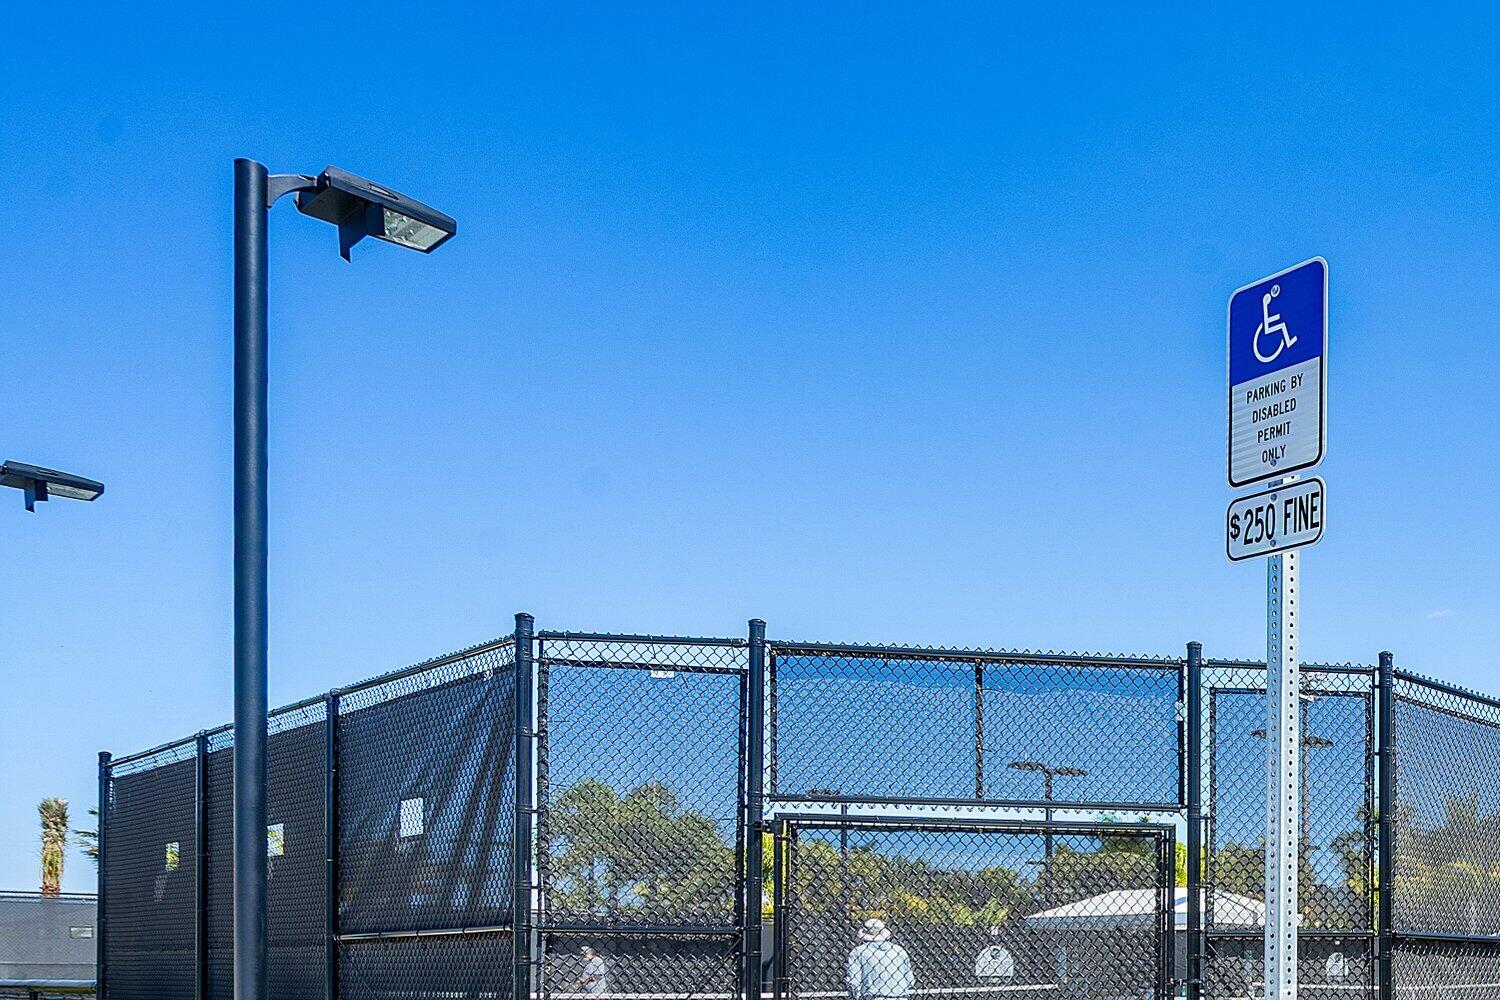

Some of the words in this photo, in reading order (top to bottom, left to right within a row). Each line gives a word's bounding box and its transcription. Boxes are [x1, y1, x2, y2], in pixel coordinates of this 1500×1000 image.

[1246, 379, 1286, 404] PARKING
[1291, 373, 1303, 388] BY
[1252, 398, 1296, 424] DISABLED
[1257, 422, 1291, 443] PERMIT
[1262, 444, 1286, 463] ONLY
[1229, 503, 1276, 546] $250
[1283, 491, 1320, 536] FINE
